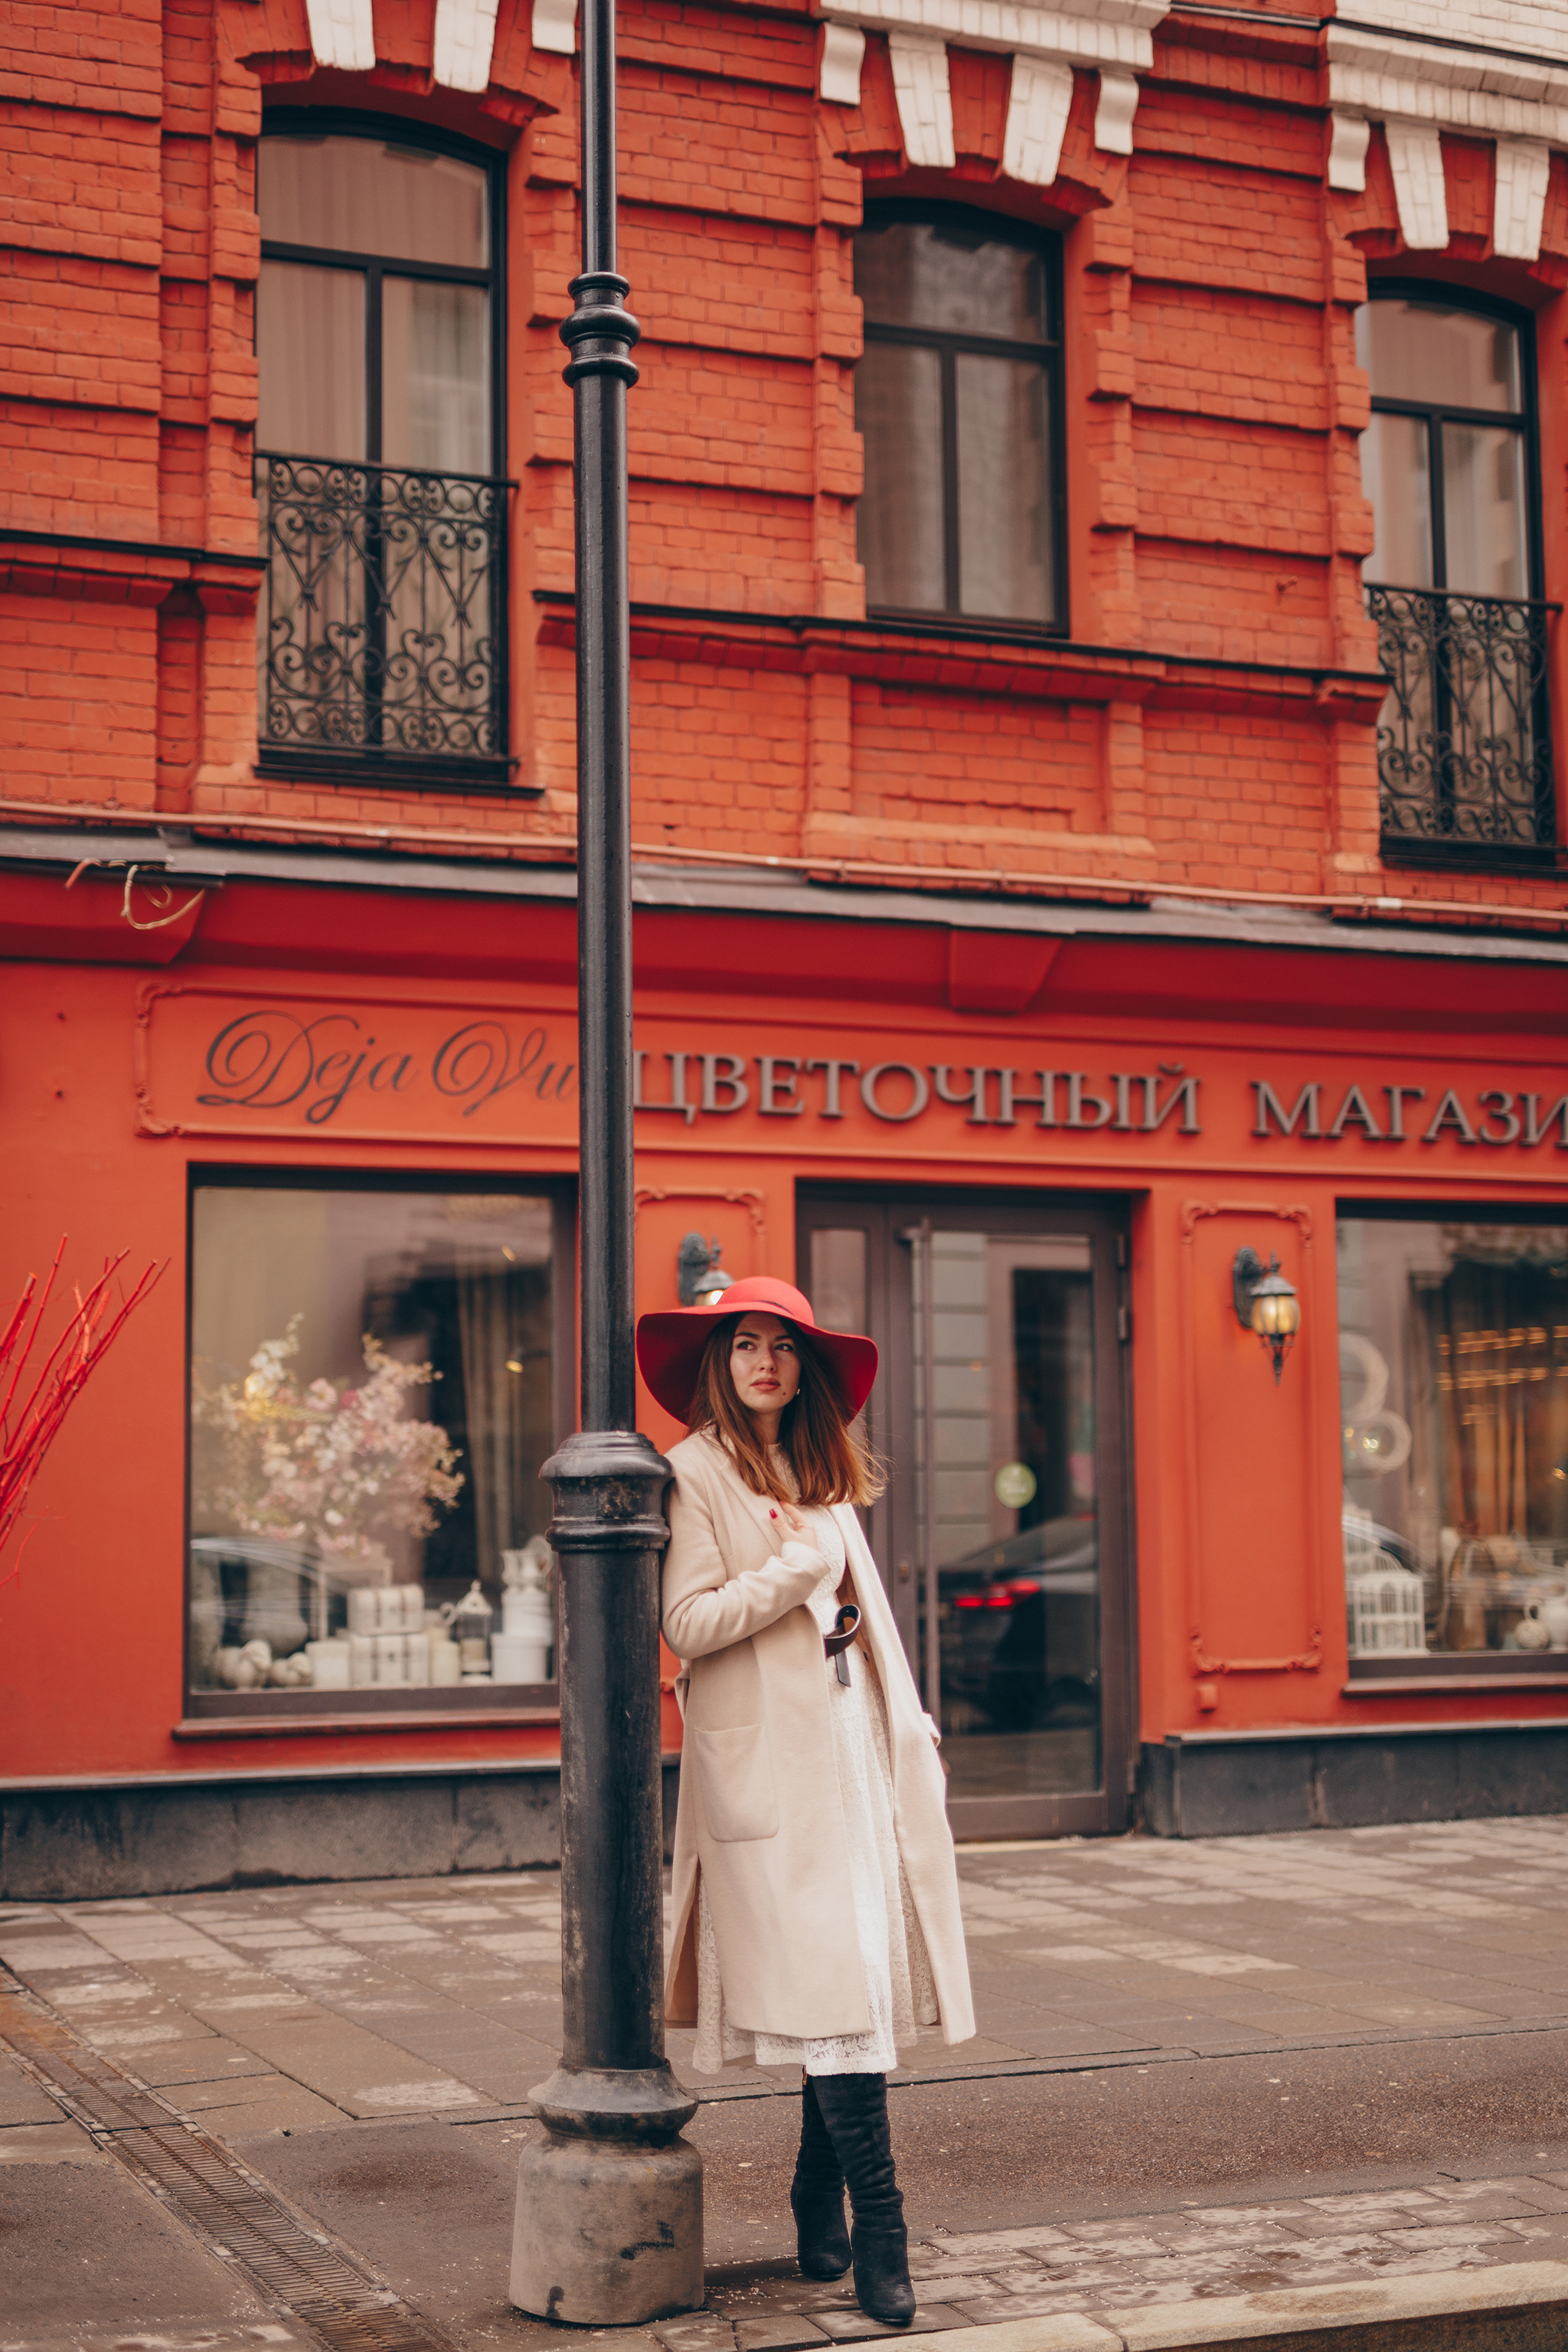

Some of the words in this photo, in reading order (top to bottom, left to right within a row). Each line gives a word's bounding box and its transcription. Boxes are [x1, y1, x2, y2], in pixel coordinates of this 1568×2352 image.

[196, 1010, 415, 1125] Deja
[432, 1020, 580, 1118] Vu
[632, 1050, 1202, 1135] ЦВЕТОЧНЫЙ
[1250, 1080, 1568, 1148] МАГАЗИ
